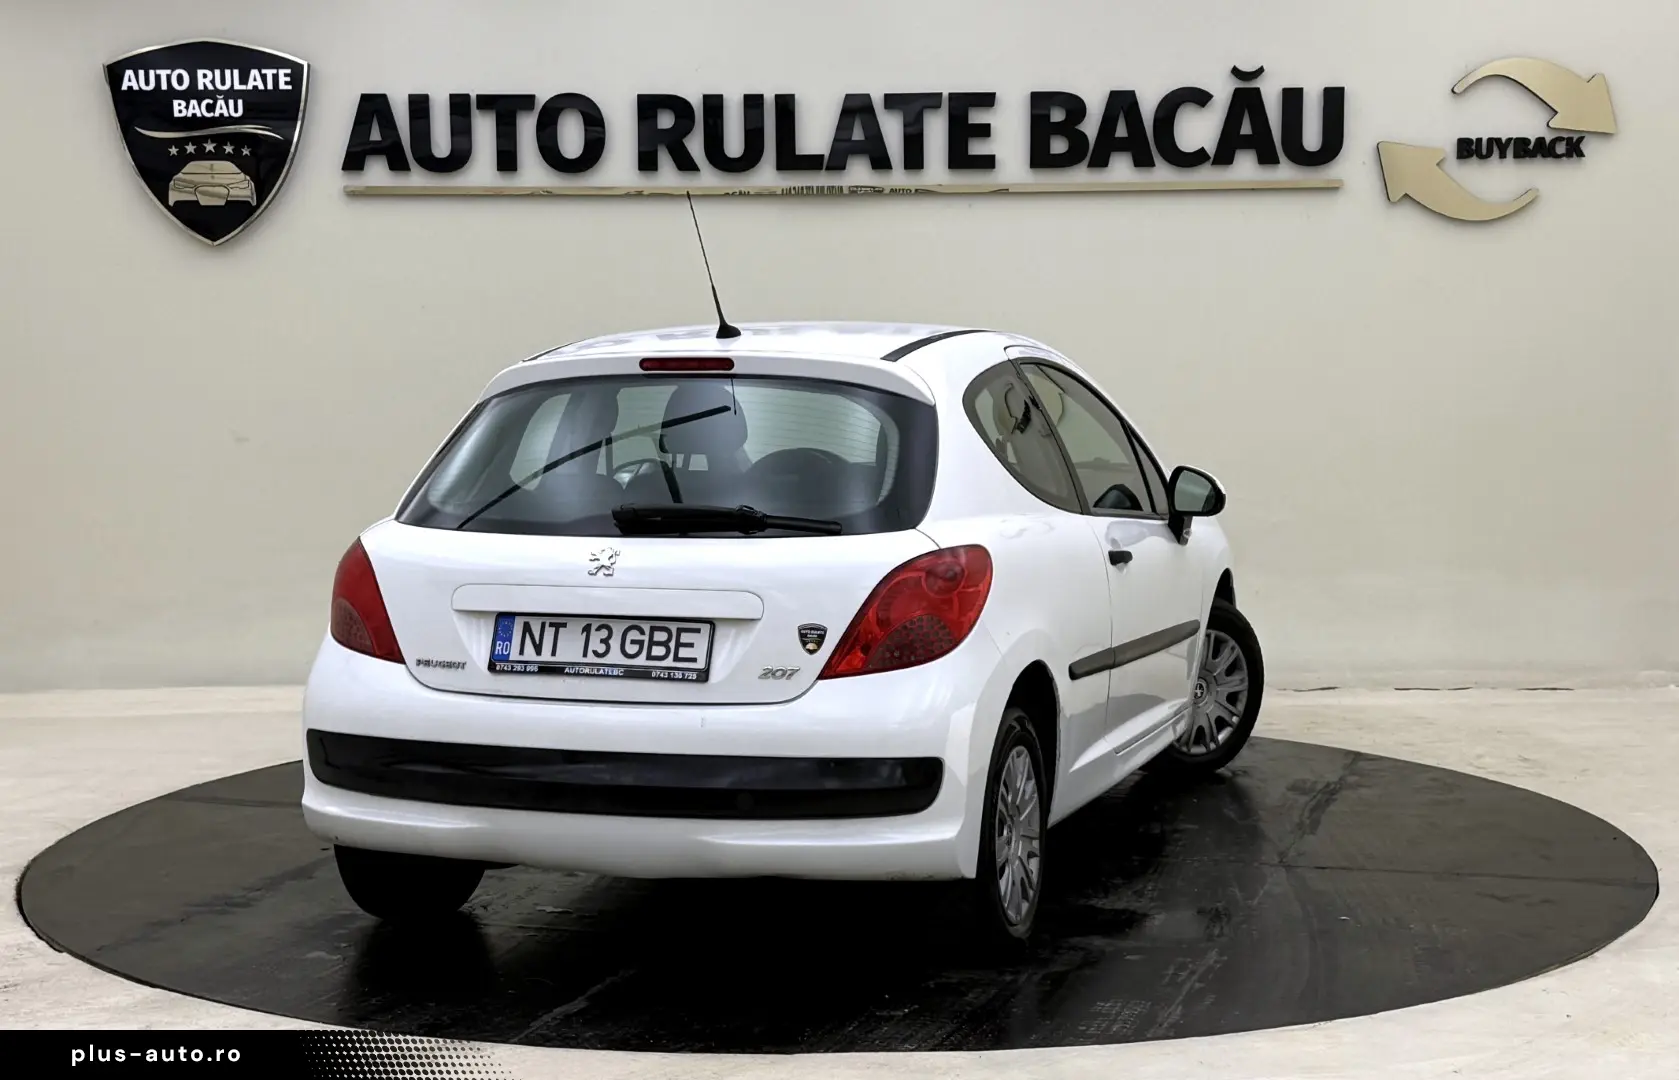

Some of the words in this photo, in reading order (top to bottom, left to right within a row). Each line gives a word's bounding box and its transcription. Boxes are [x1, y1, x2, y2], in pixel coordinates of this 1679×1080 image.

[121, 68, 190, 91] AUTO
[196, 68, 293, 91] RULATE
[173, 95, 243, 118] BACĂU
[341, 92, 606, 174] AUTO
[637, 91, 996, 174] RULATE
[1029, 65, 1345, 169] BACĂU
[1456, 135, 1586, 160] BUYBACK
[495, 641, 510, 655] RO
[518, 621, 568, 657] NT
[580, 622, 614, 659] 13
[619, 624, 702, 663] GBE
[758, 666, 801, 680] 207
